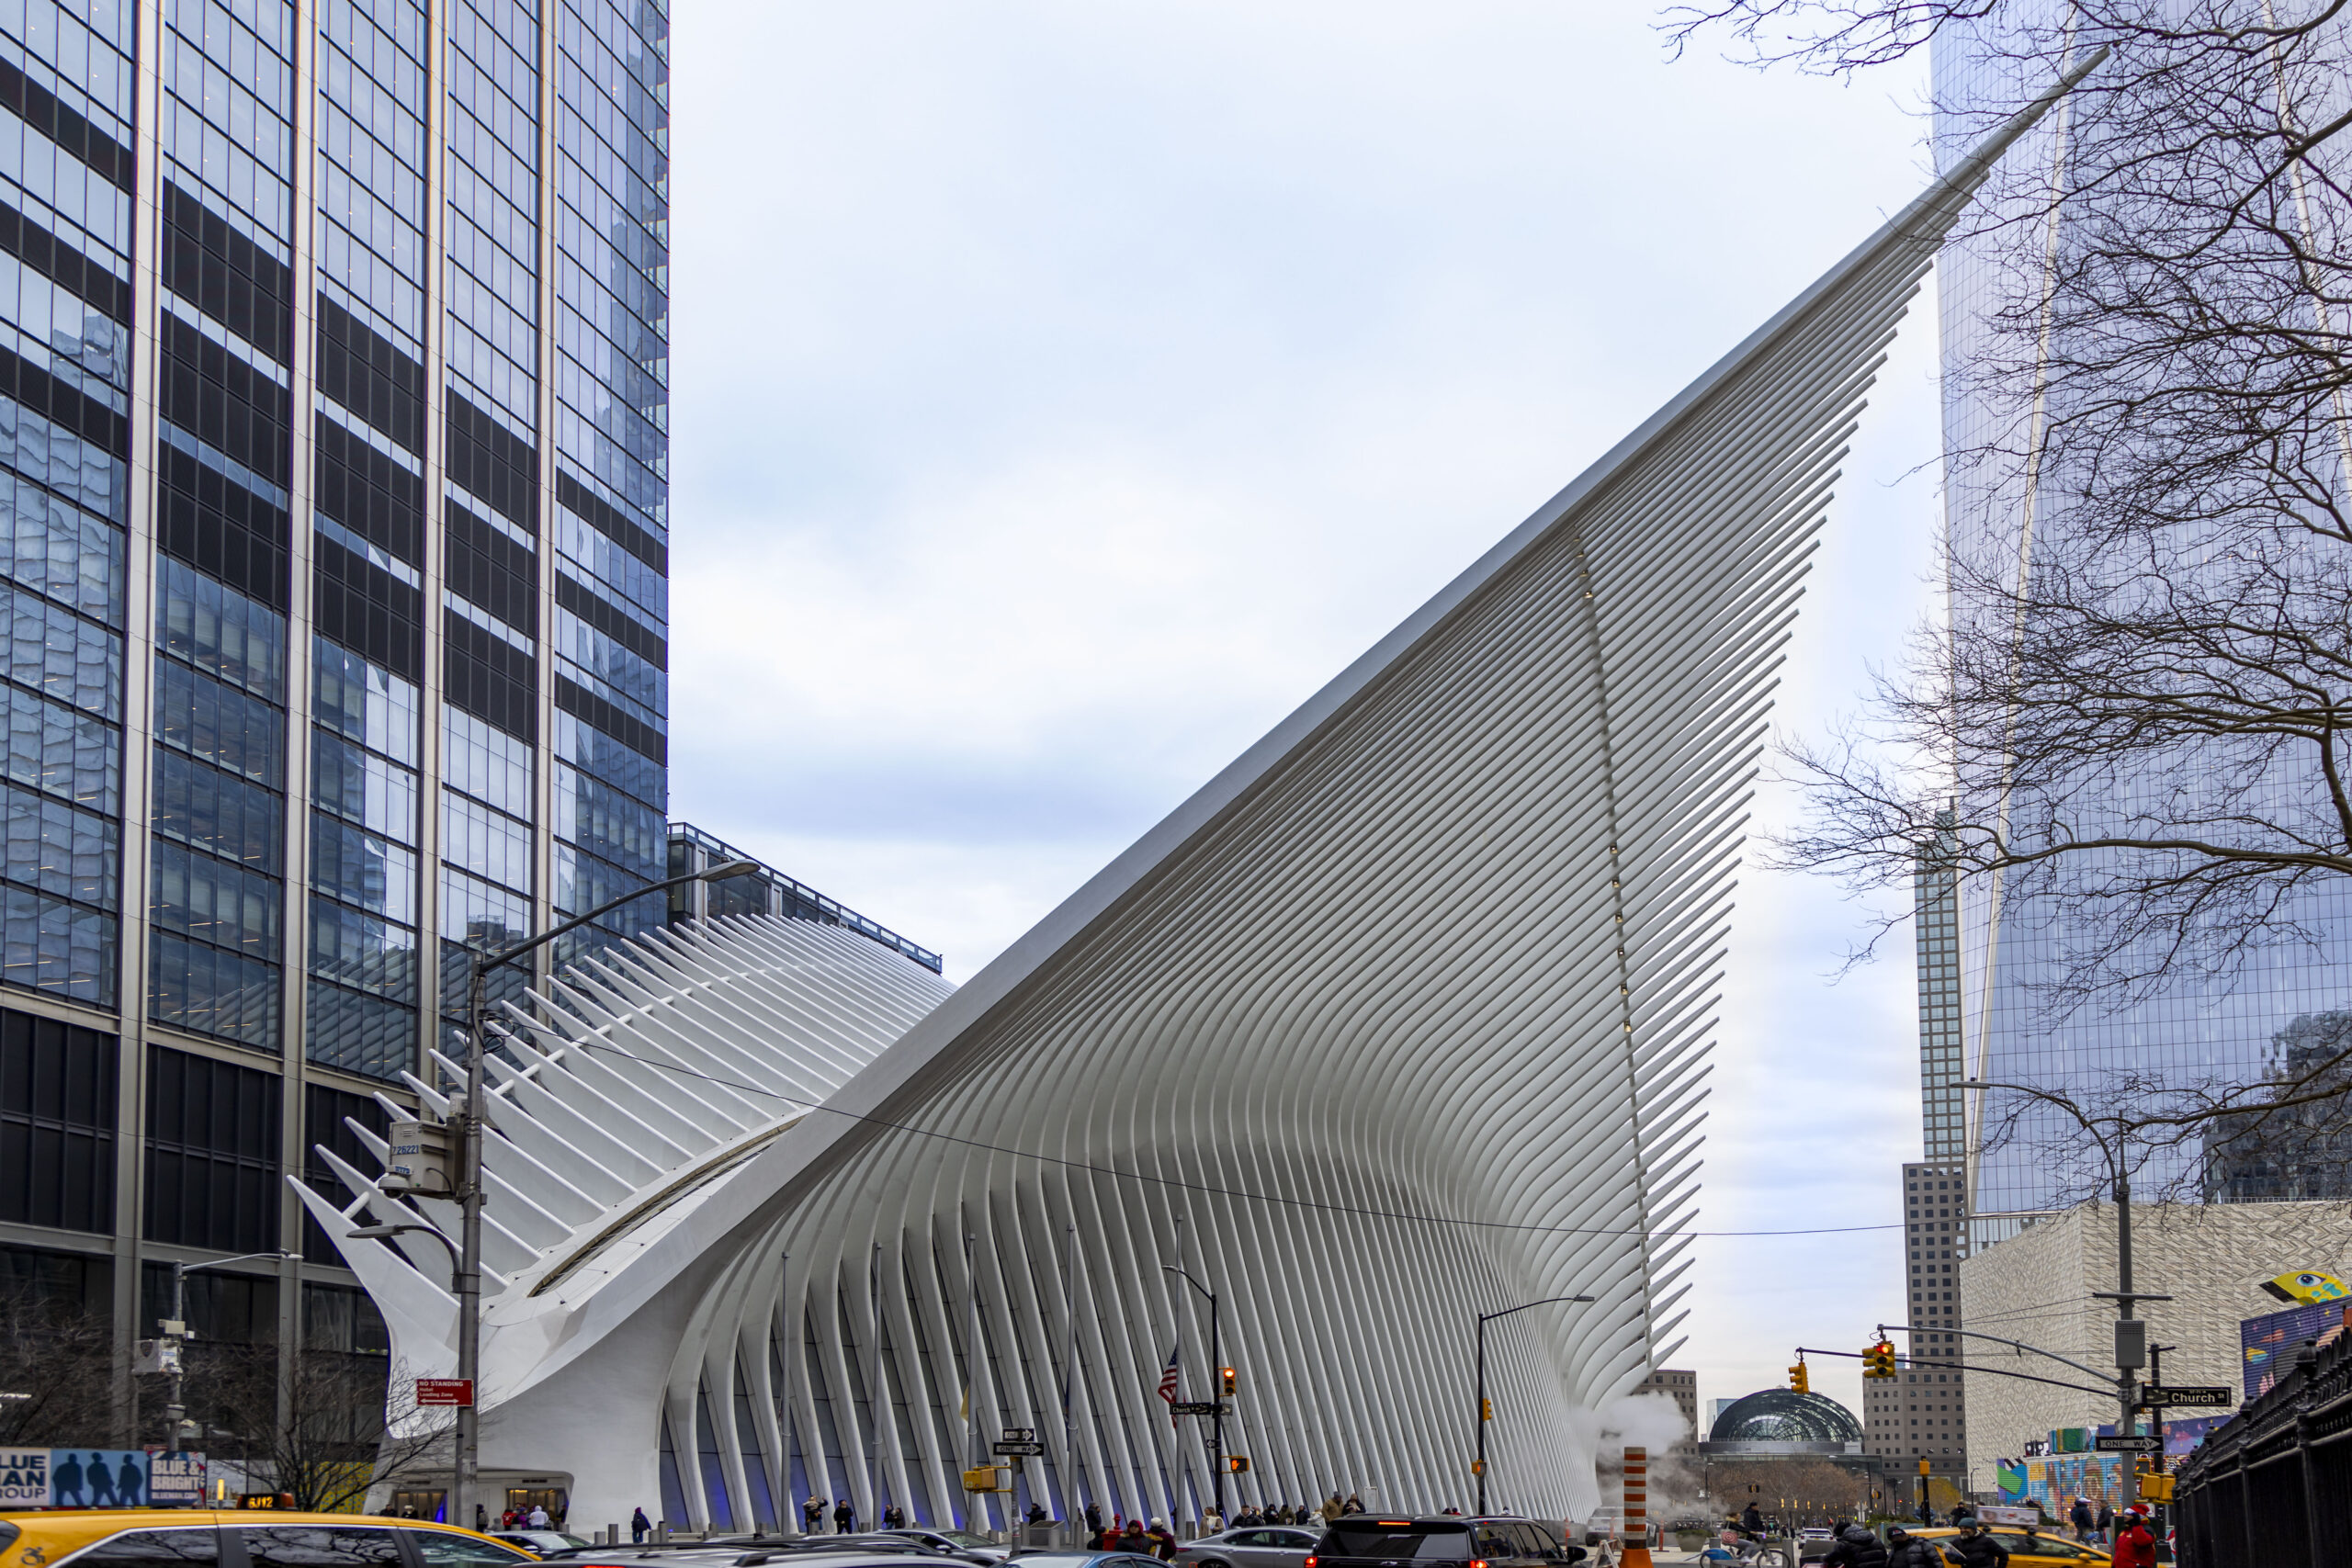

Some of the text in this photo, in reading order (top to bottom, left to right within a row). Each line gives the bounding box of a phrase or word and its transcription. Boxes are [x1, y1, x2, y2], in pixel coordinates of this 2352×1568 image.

[2171, 1393, 2216, 1403] Church
[152, 1461, 199, 1475] BLUE &
[0, 1470, 46, 1486] AN
[152, 1476, 198, 1489] BRIGHT
